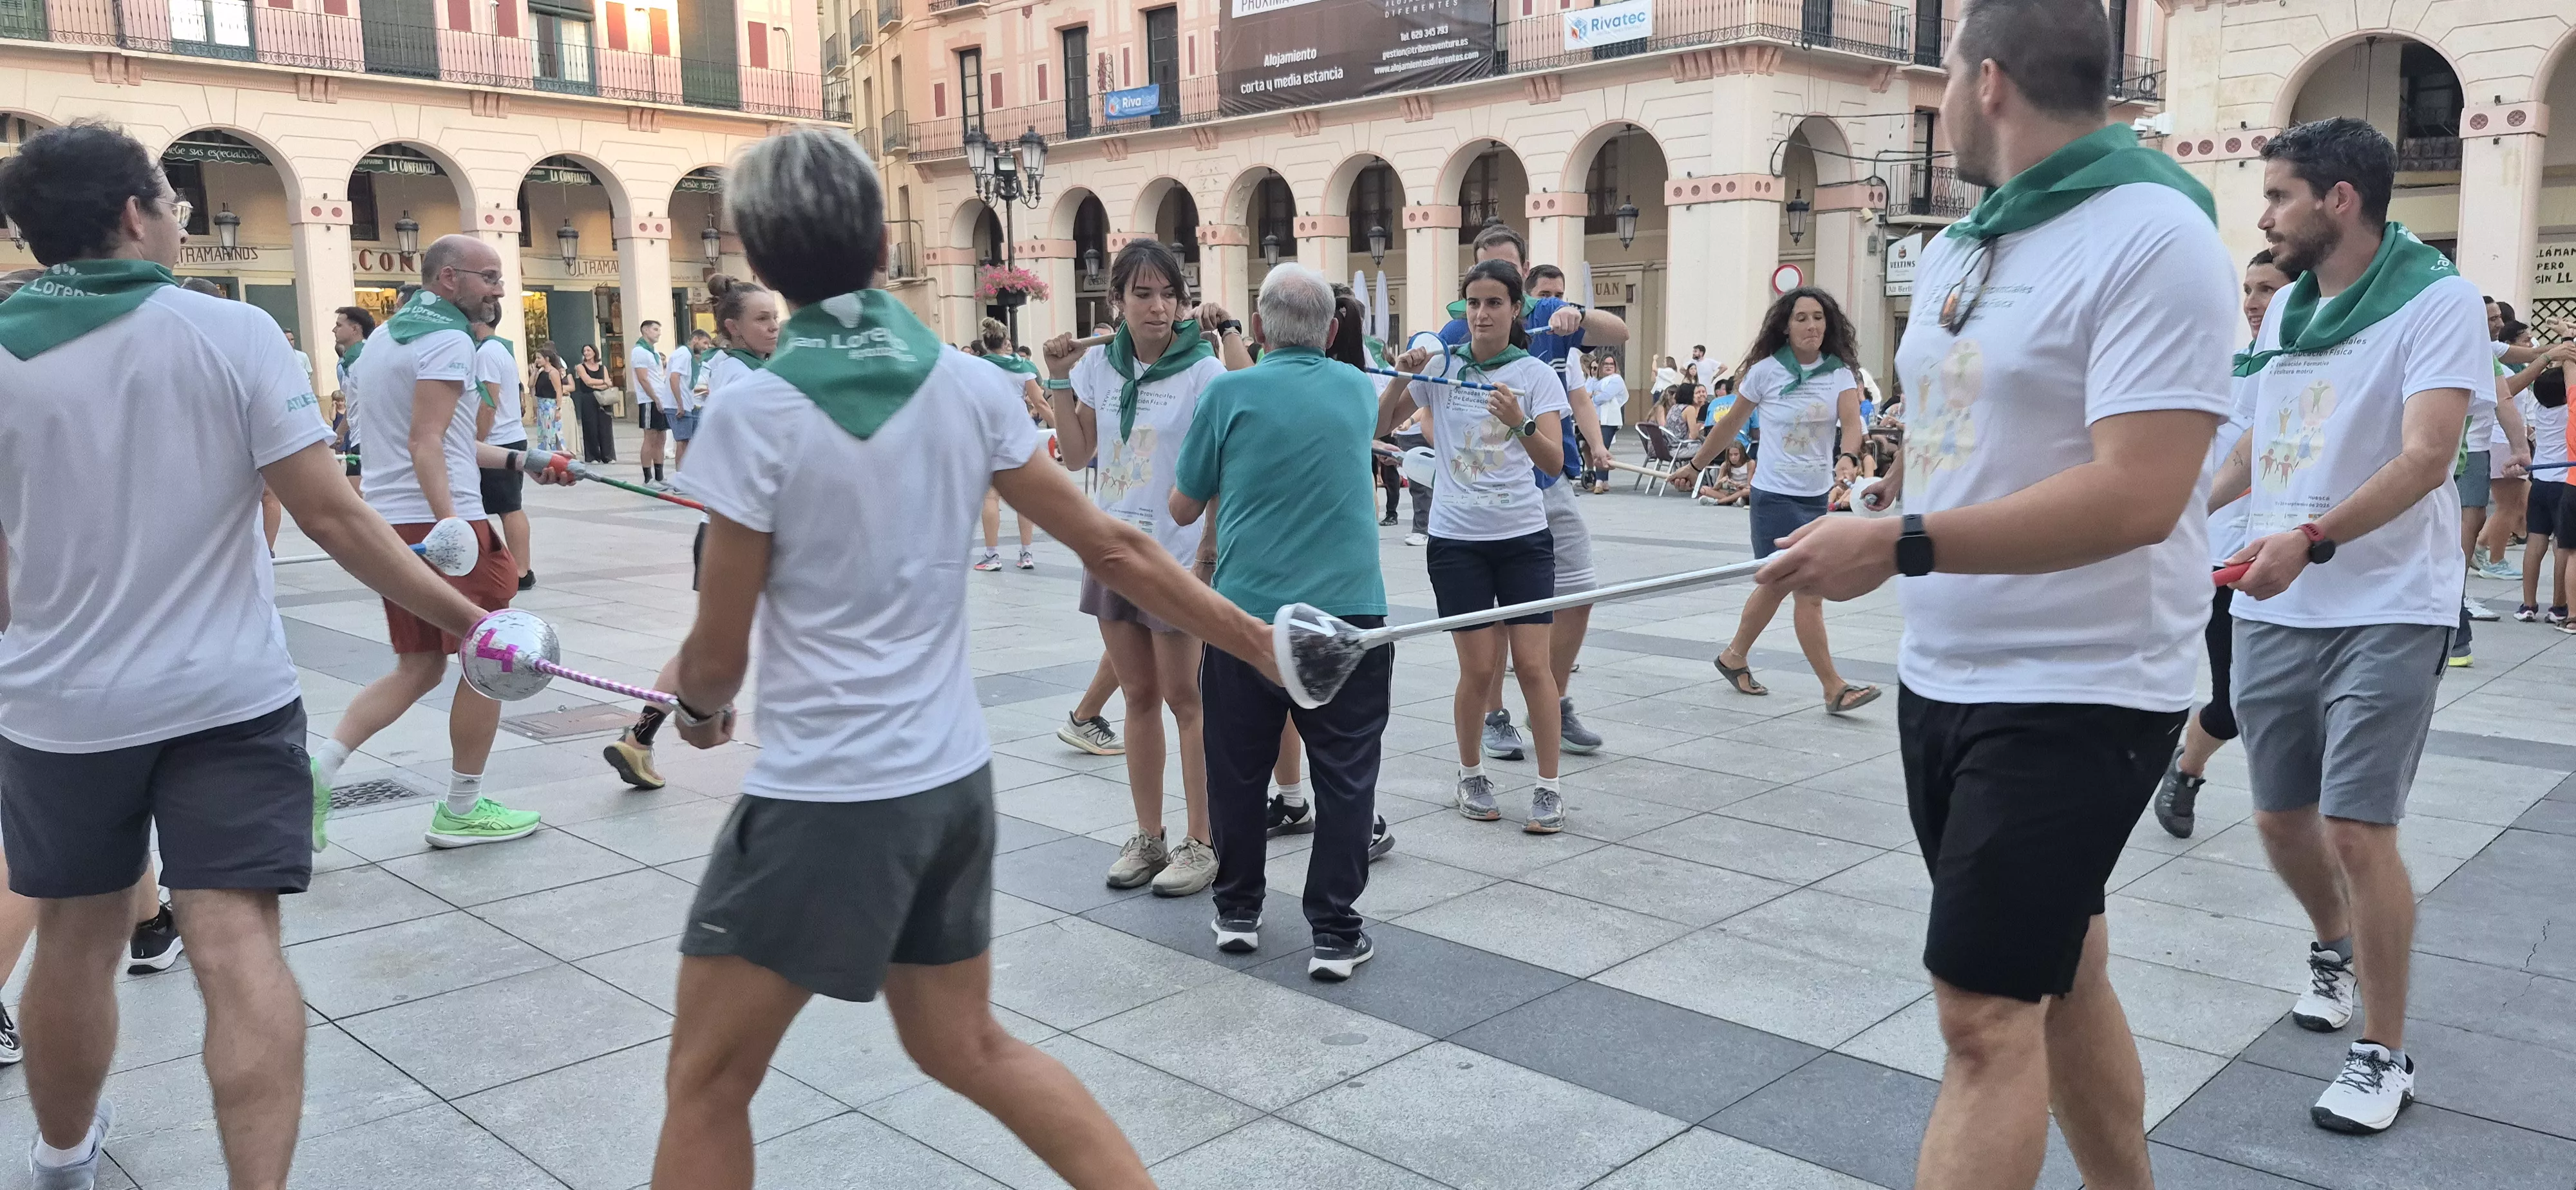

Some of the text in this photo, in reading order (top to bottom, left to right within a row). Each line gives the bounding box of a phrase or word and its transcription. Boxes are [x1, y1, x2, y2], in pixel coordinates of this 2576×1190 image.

[1385, 0, 1458, 18] DIFERENTES
[1591, 12, 1646, 32] Rivatec
[1411, 30, 1423, 40] 629
[1424, 27, 1436, 37] 345
[1437, 25, 1448, 35] 793
[1264, 46, 1317, 68] Alojamiento
[1374, 51, 1479, 75] www.alojamientosdiferentes.com
[1240, 66, 1344, 94] corta y media estancia
[189, 148, 204, 156] sus
[389, 158, 399, 171] LA
[399, 160, 436, 174] CONFIANZA
[550, 169, 592, 184] LA CONFIANZA
[359, 249, 424, 273] CON
[568, 260, 619, 276] ULTRAMA
[1889, 260, 1916, 269] VELTINS
[2537, 261, 2564, 271] PERO
[2535, 272, 2573, 284] SIN LL
[30, 278, 108, 296] Loren
[1595, 282, 1620, 296] UAN
[2329, 348, 2353, 356] Física
[1462, 396, 1488, 404] Educació
